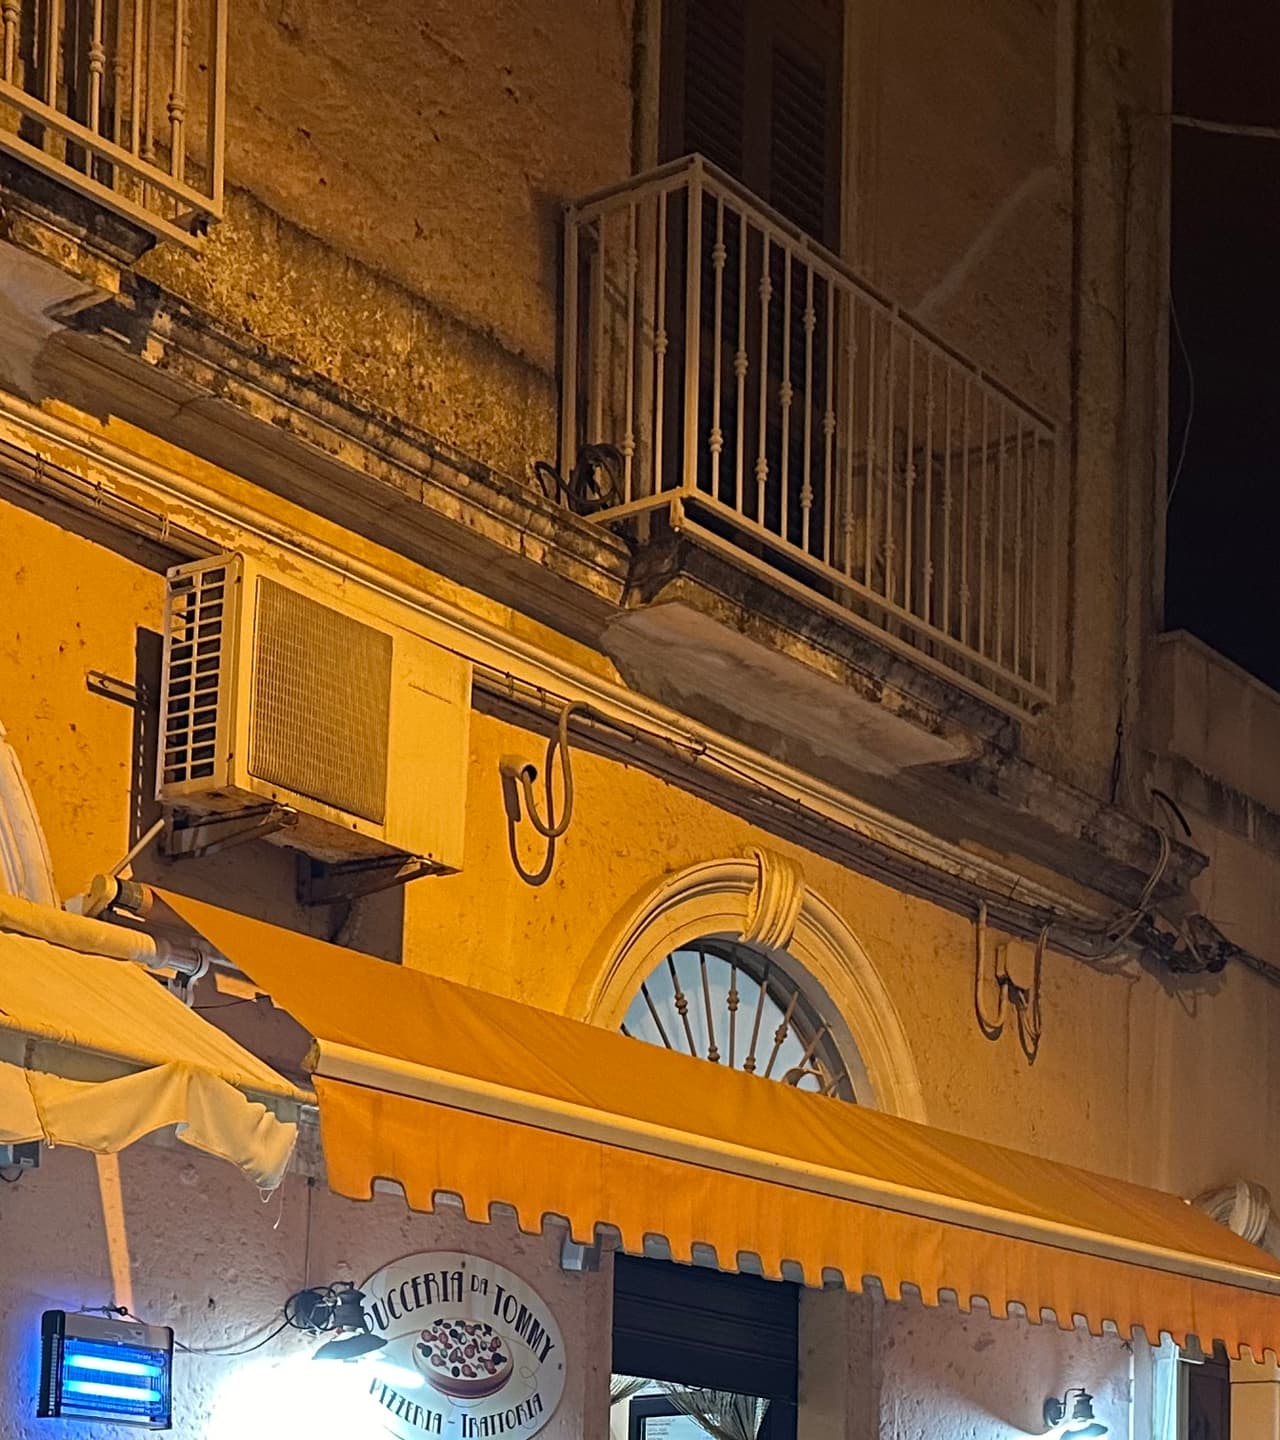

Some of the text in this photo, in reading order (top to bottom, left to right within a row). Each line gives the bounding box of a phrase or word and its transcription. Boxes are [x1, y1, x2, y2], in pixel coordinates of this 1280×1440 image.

[471, 1274, 488, 1296] DA
[493, 1284, 555, 1364] TOMMY
[369, 1377, 442, 1435] PIZZERIA
[461, 1393, 544, 1438] TRATTORIA
